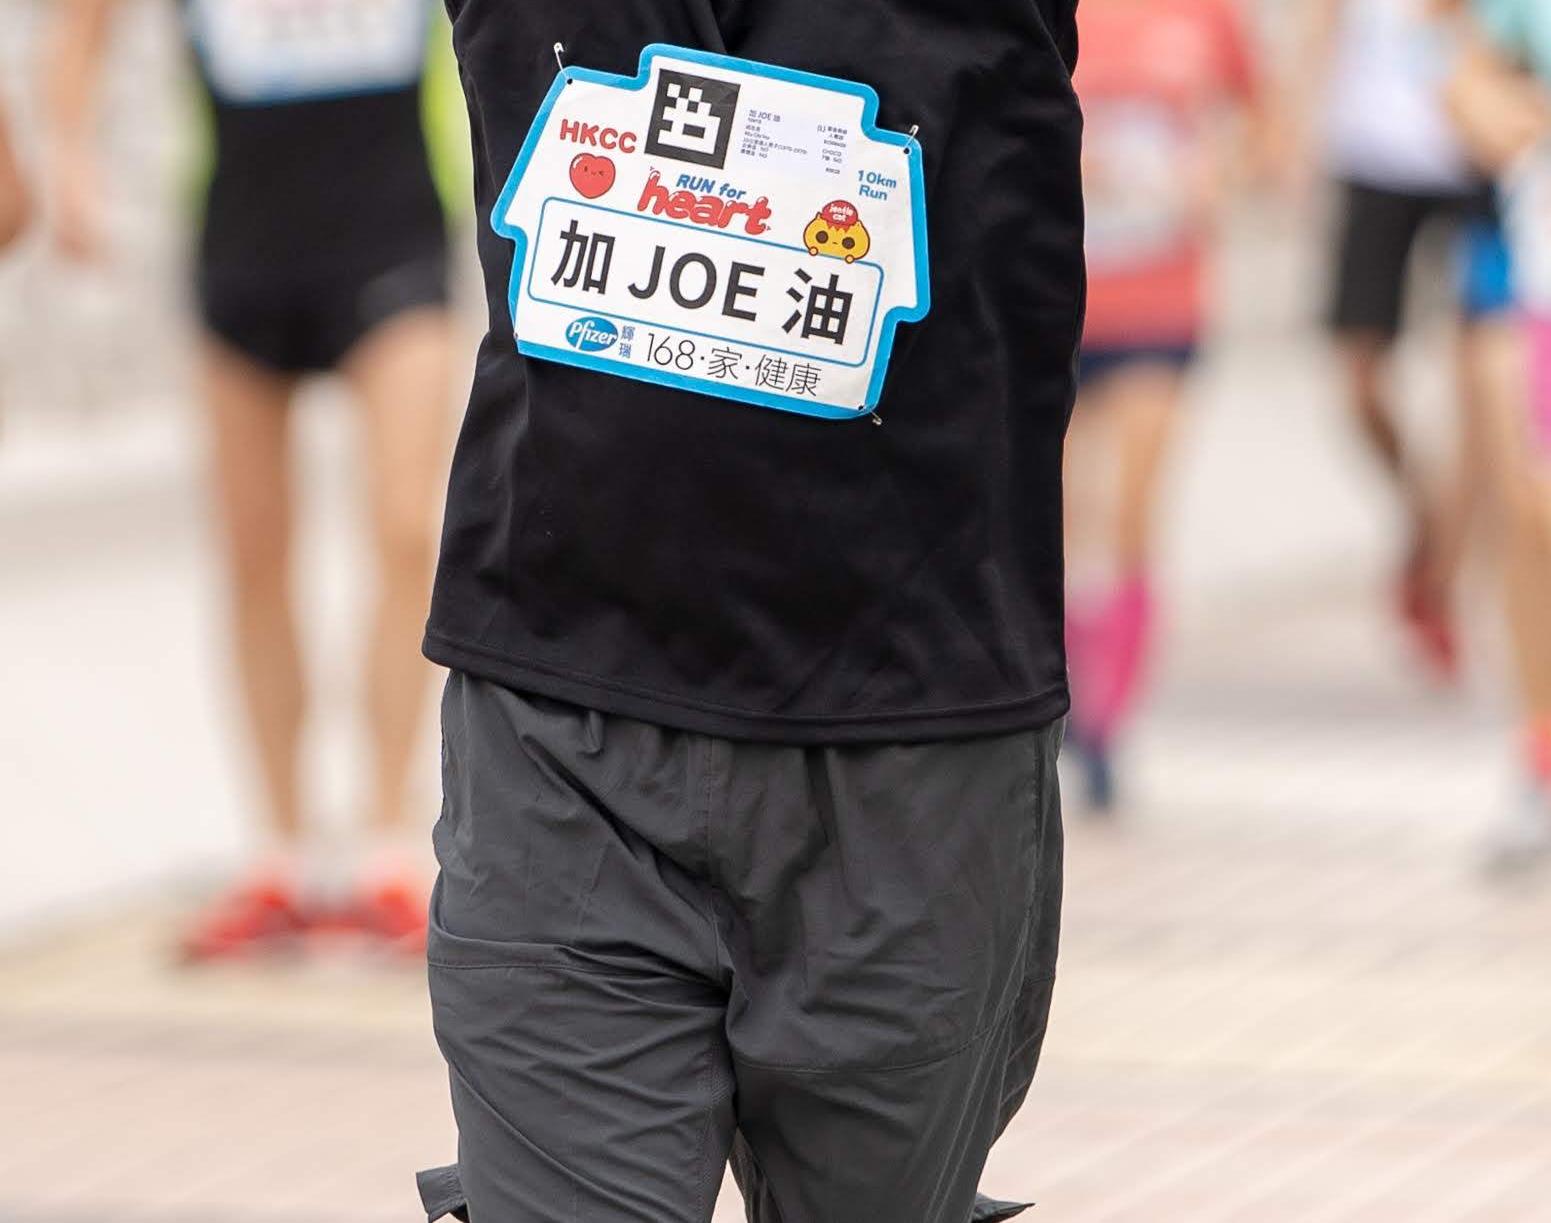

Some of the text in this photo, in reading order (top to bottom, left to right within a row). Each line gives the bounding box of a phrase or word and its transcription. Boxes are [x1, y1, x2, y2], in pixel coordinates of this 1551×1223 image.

[559, 119, 637, 153] HKCC
[676, 174, 747, 199] RUN for
[858, 169, 897, 188] 10km
[859, 184, 888, 201] Run
[637, 170, 772, 235] heart
[550, 219, 853, 345] 加 JOE 油
[568, 320, 618, 351] Pfizer
